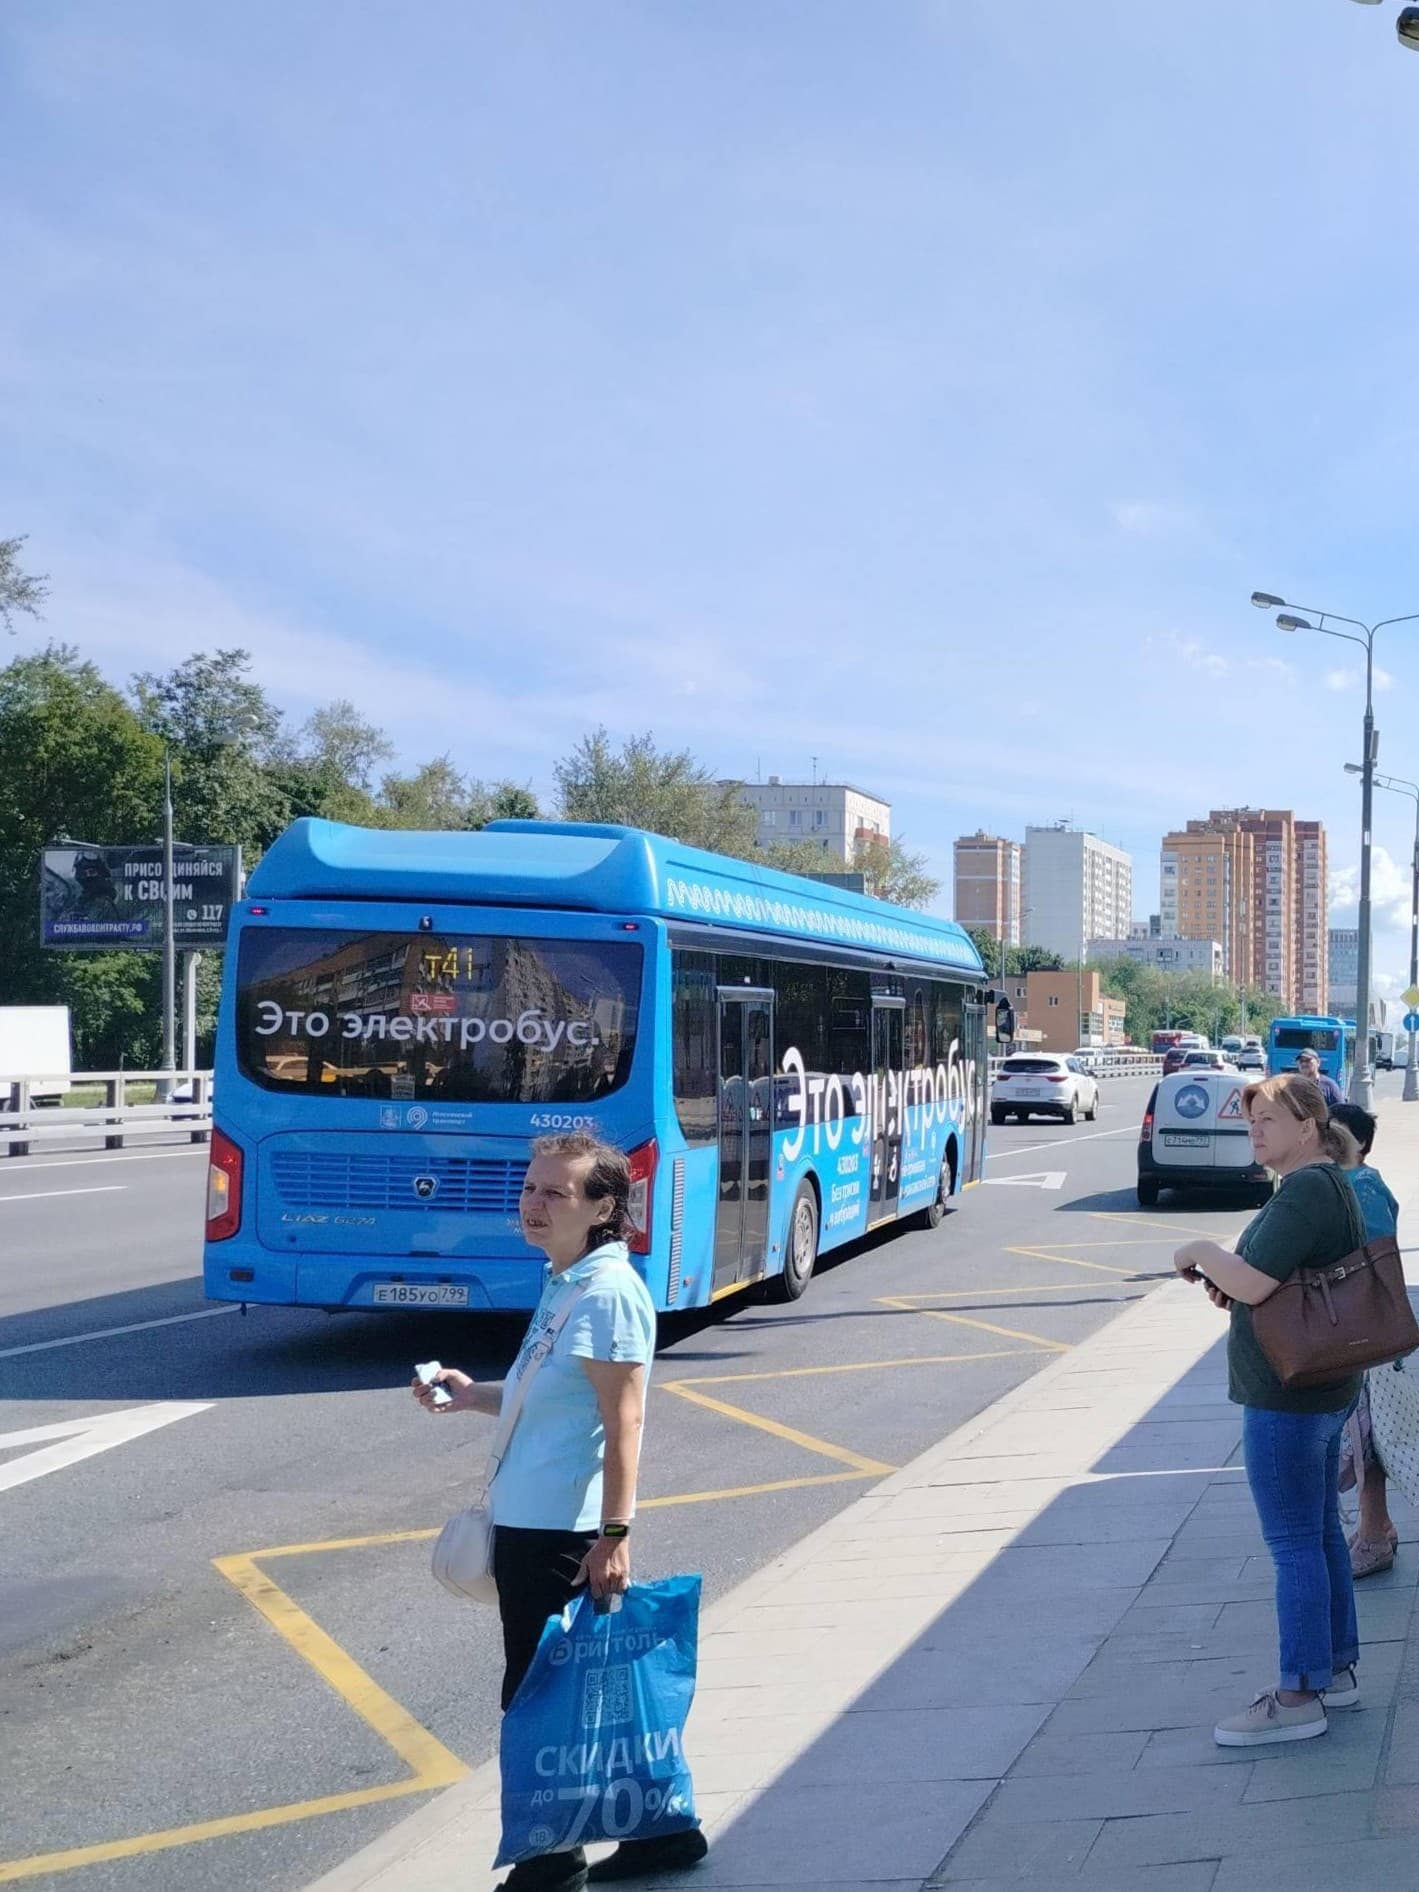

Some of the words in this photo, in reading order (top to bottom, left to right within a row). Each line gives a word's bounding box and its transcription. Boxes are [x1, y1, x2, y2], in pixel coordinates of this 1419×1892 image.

[124, 860, 223, 878] ПРИСОДИНЯЙСЯ
[202, 904, 224, 921] 117
[255, 1000, 330, 1037] Это
[341, 1009, 600, 1052] электробус.
[782, 1047, 845, 1161] Это
[530, 1113, 595, 1130] 430203
[535, 1727, 680, 1778] СКИДКИ
